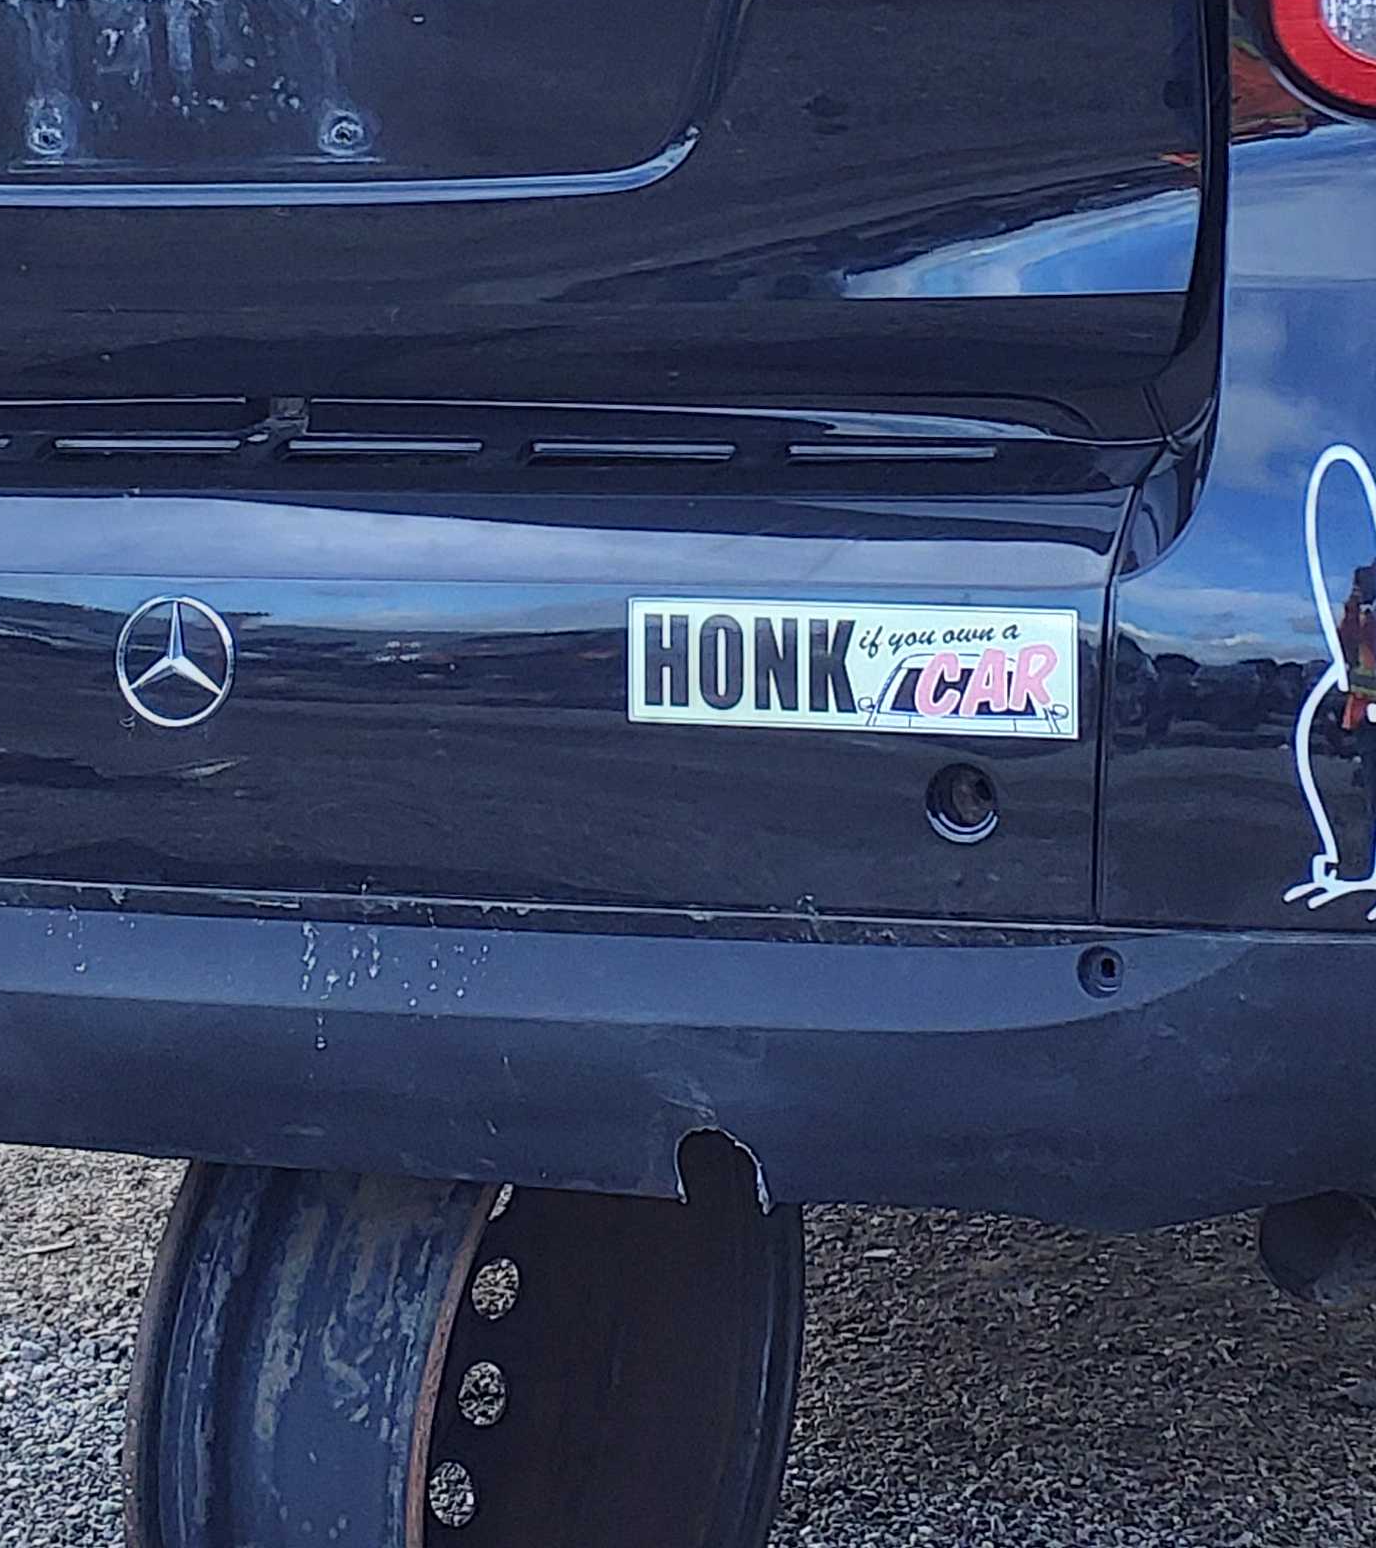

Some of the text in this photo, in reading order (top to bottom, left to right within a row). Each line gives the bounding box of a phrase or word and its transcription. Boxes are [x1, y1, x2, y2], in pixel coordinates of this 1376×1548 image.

[644, 614, 858, 714] HONK
[859, 624, 1022, 659] if you own a
[914, 643, 1058, 717] CAR
